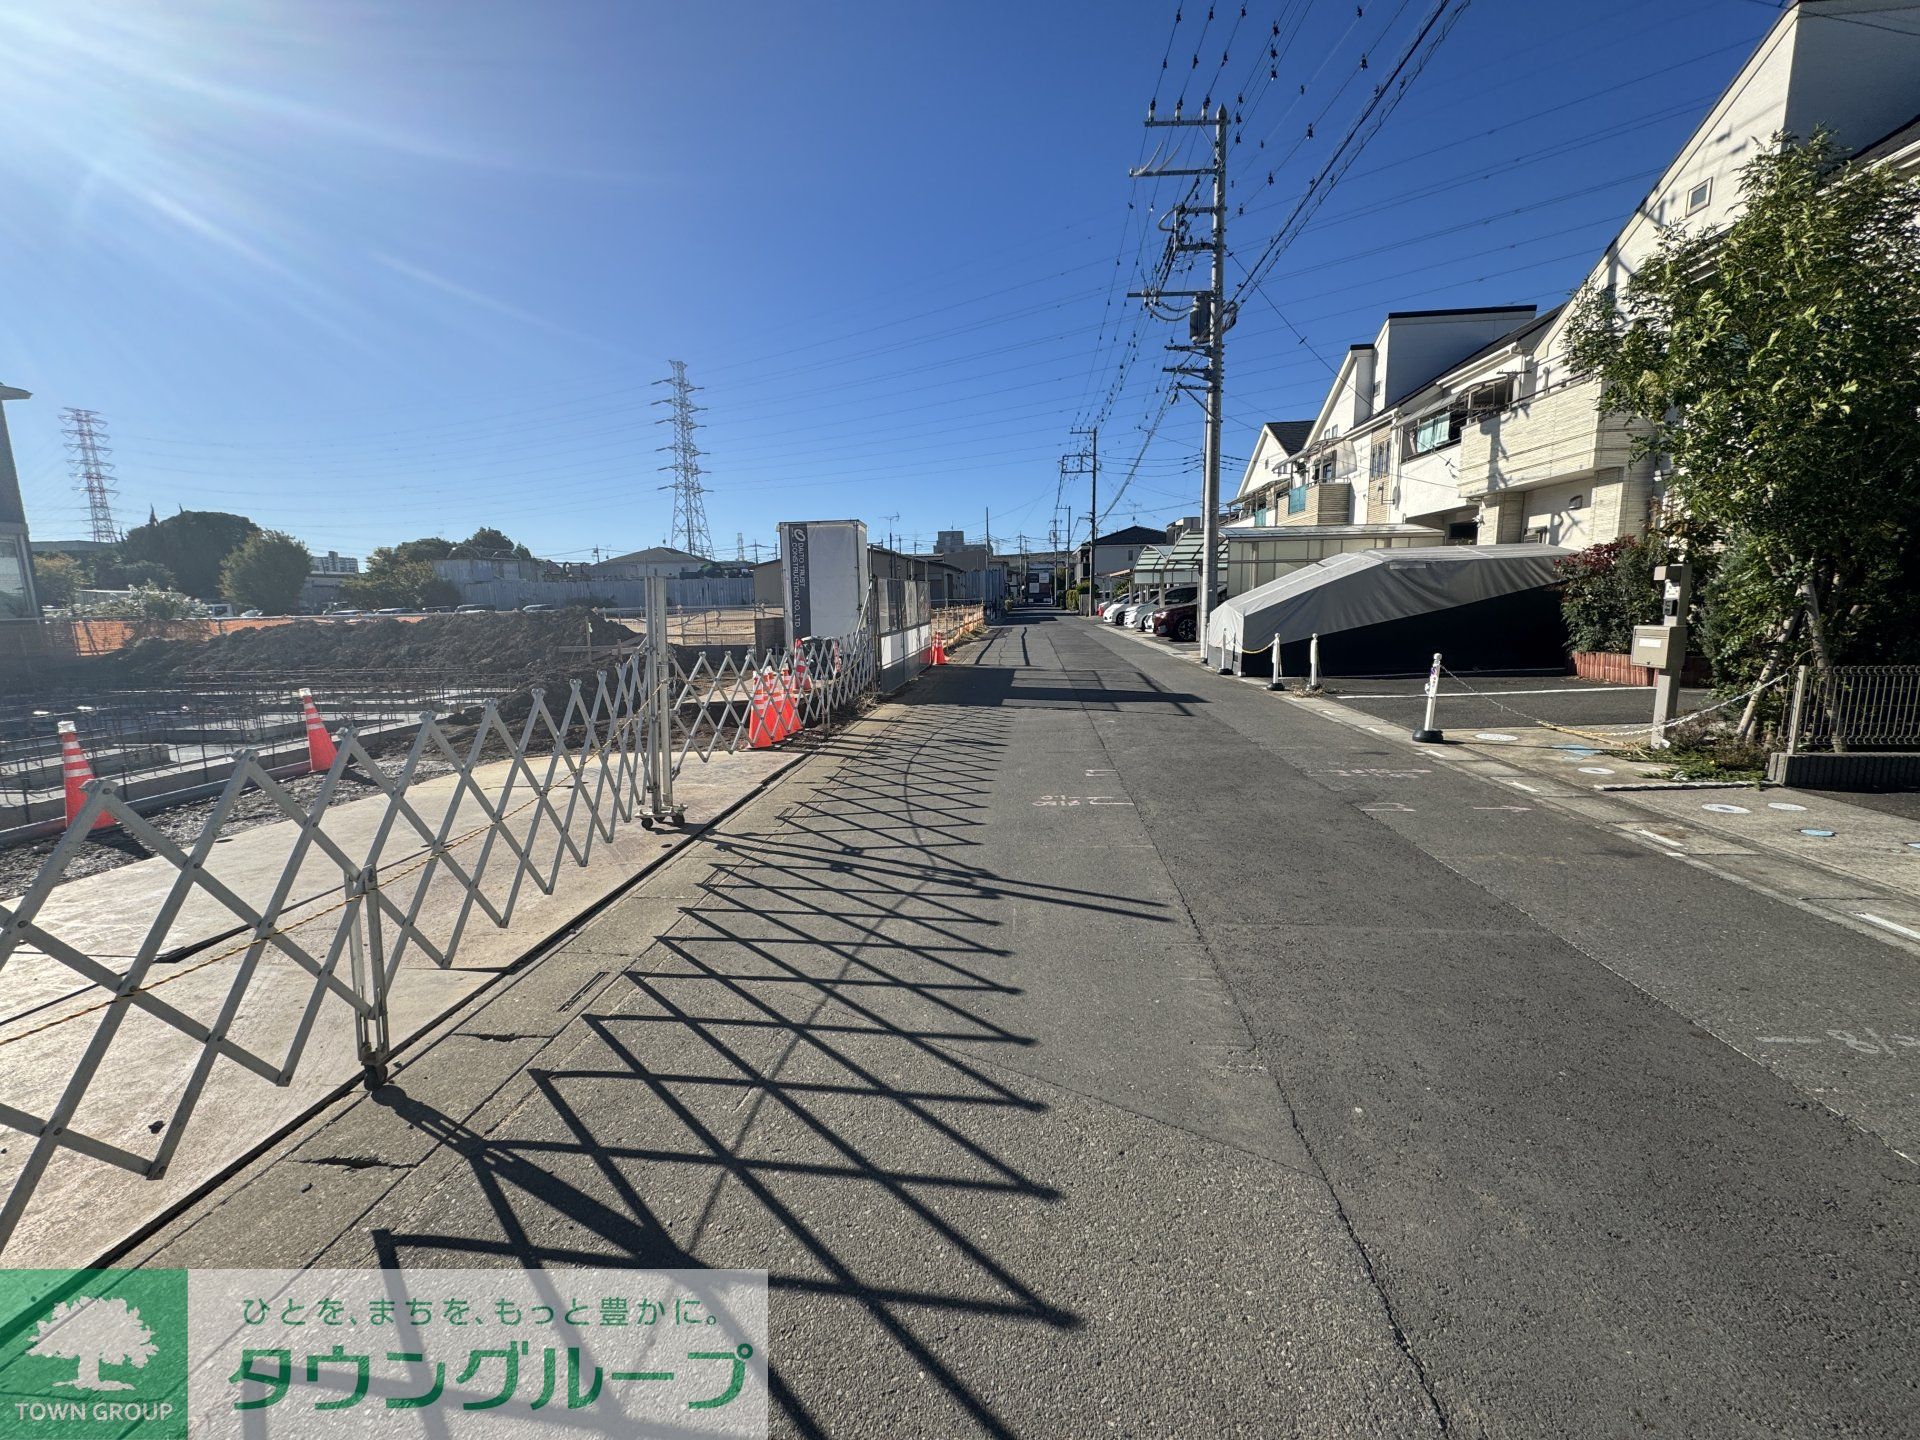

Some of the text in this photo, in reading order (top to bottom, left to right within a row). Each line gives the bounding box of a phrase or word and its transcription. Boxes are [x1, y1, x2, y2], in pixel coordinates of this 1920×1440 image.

[792, 543, 801, 598] CONSTRUCTION
[798, 543, 806, 588] DAITO TRUST
